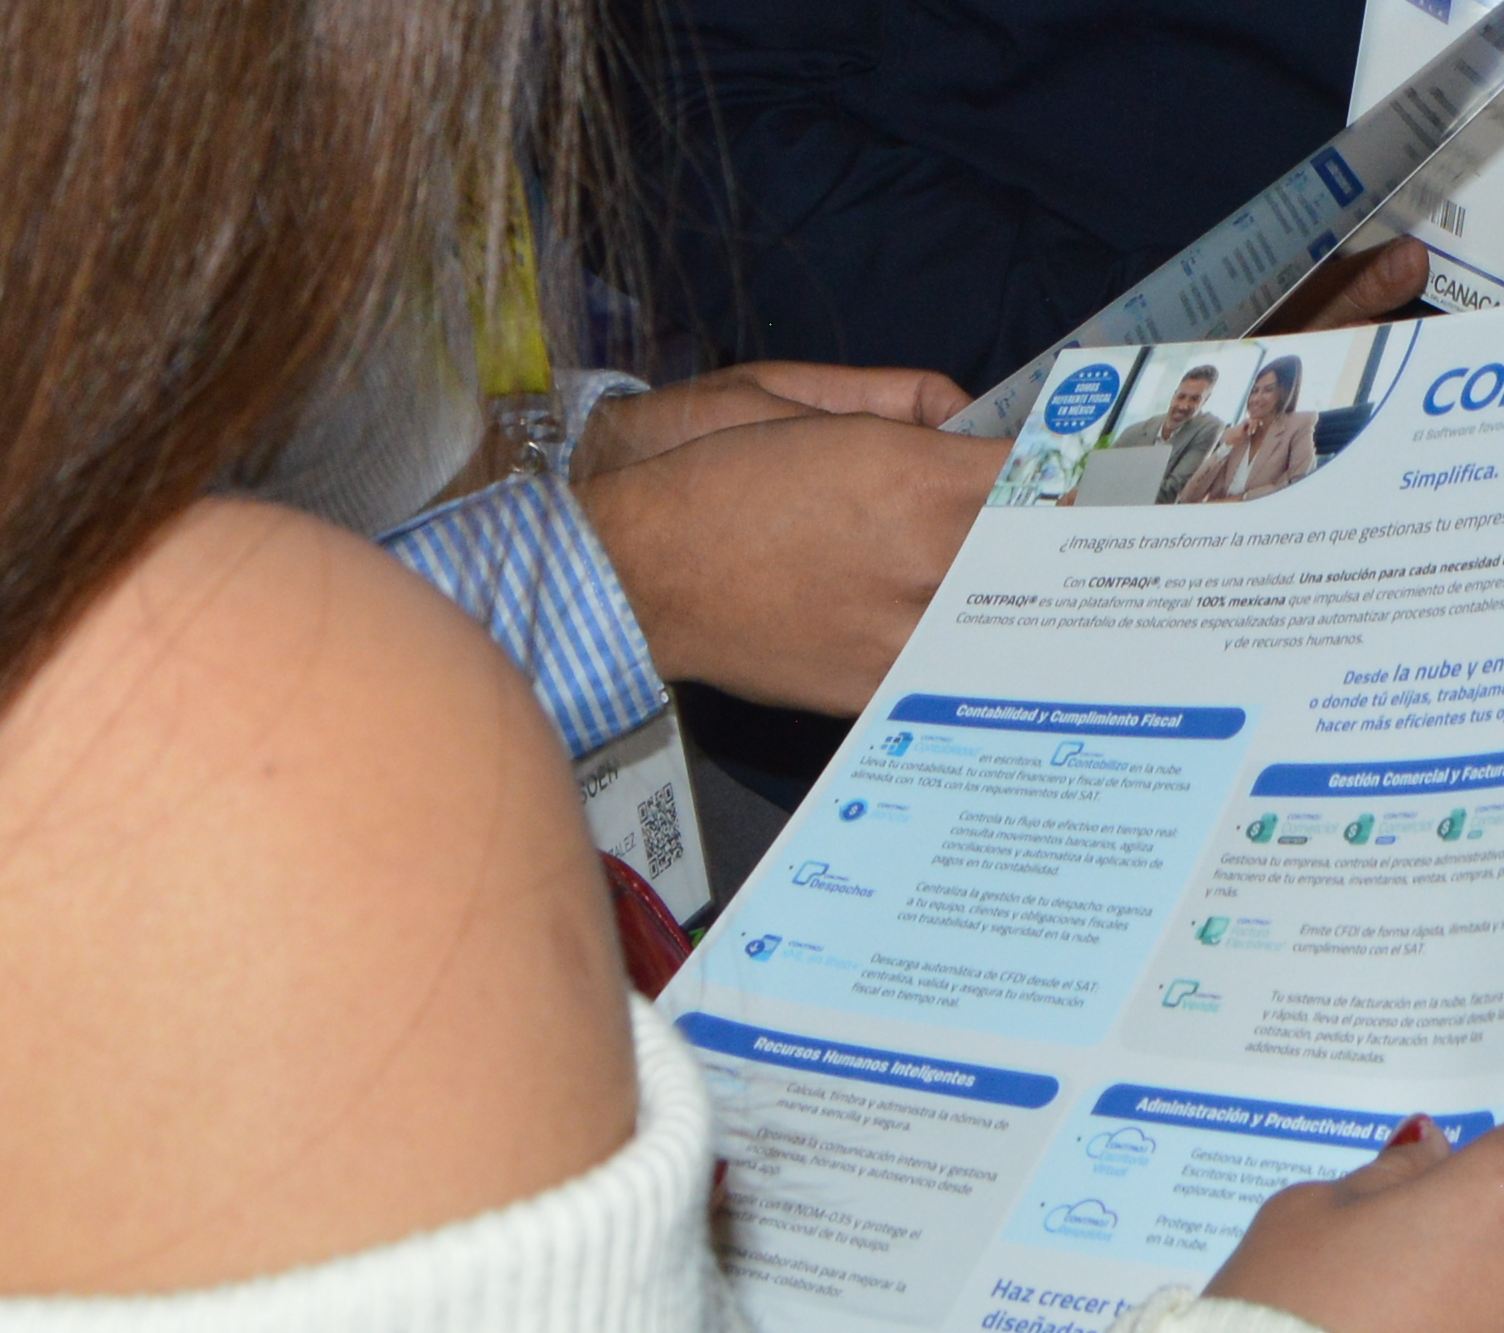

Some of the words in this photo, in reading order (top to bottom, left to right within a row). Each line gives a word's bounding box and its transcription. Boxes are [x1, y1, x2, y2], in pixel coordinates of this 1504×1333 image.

[1435, 274, 1500, 310] CANAC
[1400, 463, 1498, 491] Simplifica.
[1344, 670, 1389, 685] Desde
[1393, 664, 1411, 682] la
[1415, 659, 1462, 681] nube
[1467, 660, 1478, 680] y
[1482, 657, 1504, 674] en
[1309, 697, 1318, 709] o
[1322, 694, 1367, 709] donde
[1372, 692, 1388, 708] tú
[1391, 689, 1433, 709] elijas,
[956, 704, 1036, 724] Contabilidad
[1038, 711, 1047, 724] y
[1050, 709, 1139, 728] Cumplimiento
[1141, 713, 1183, 728] Fiscal
[1316, 717, 1358, 733] hacer
[1360, 714, 1391, 731] más
[1395, 709, 1465, 728] eficientes
[1470, 707, 1492, 723] tus
[1328, 772, 1380, 788] Gestión
[1383, 767, 1449, 787] Comercial
[1451, 770, 1459, 784] y
[754, 1036, 820, 1062] Recursos
[822, 1049, 889, 1073] Humanos
[890, 1061, 976, 1089] Inteligentes
[1137, 1096, 1250, 1125] Administración
[1252, 1113, 1263, 1128] y
[1265, 1113, 1370, 1140] Productividad
[991, 1278, 1034, 1304] Haz
[1038, 1288, 1111, 1317] crecer
